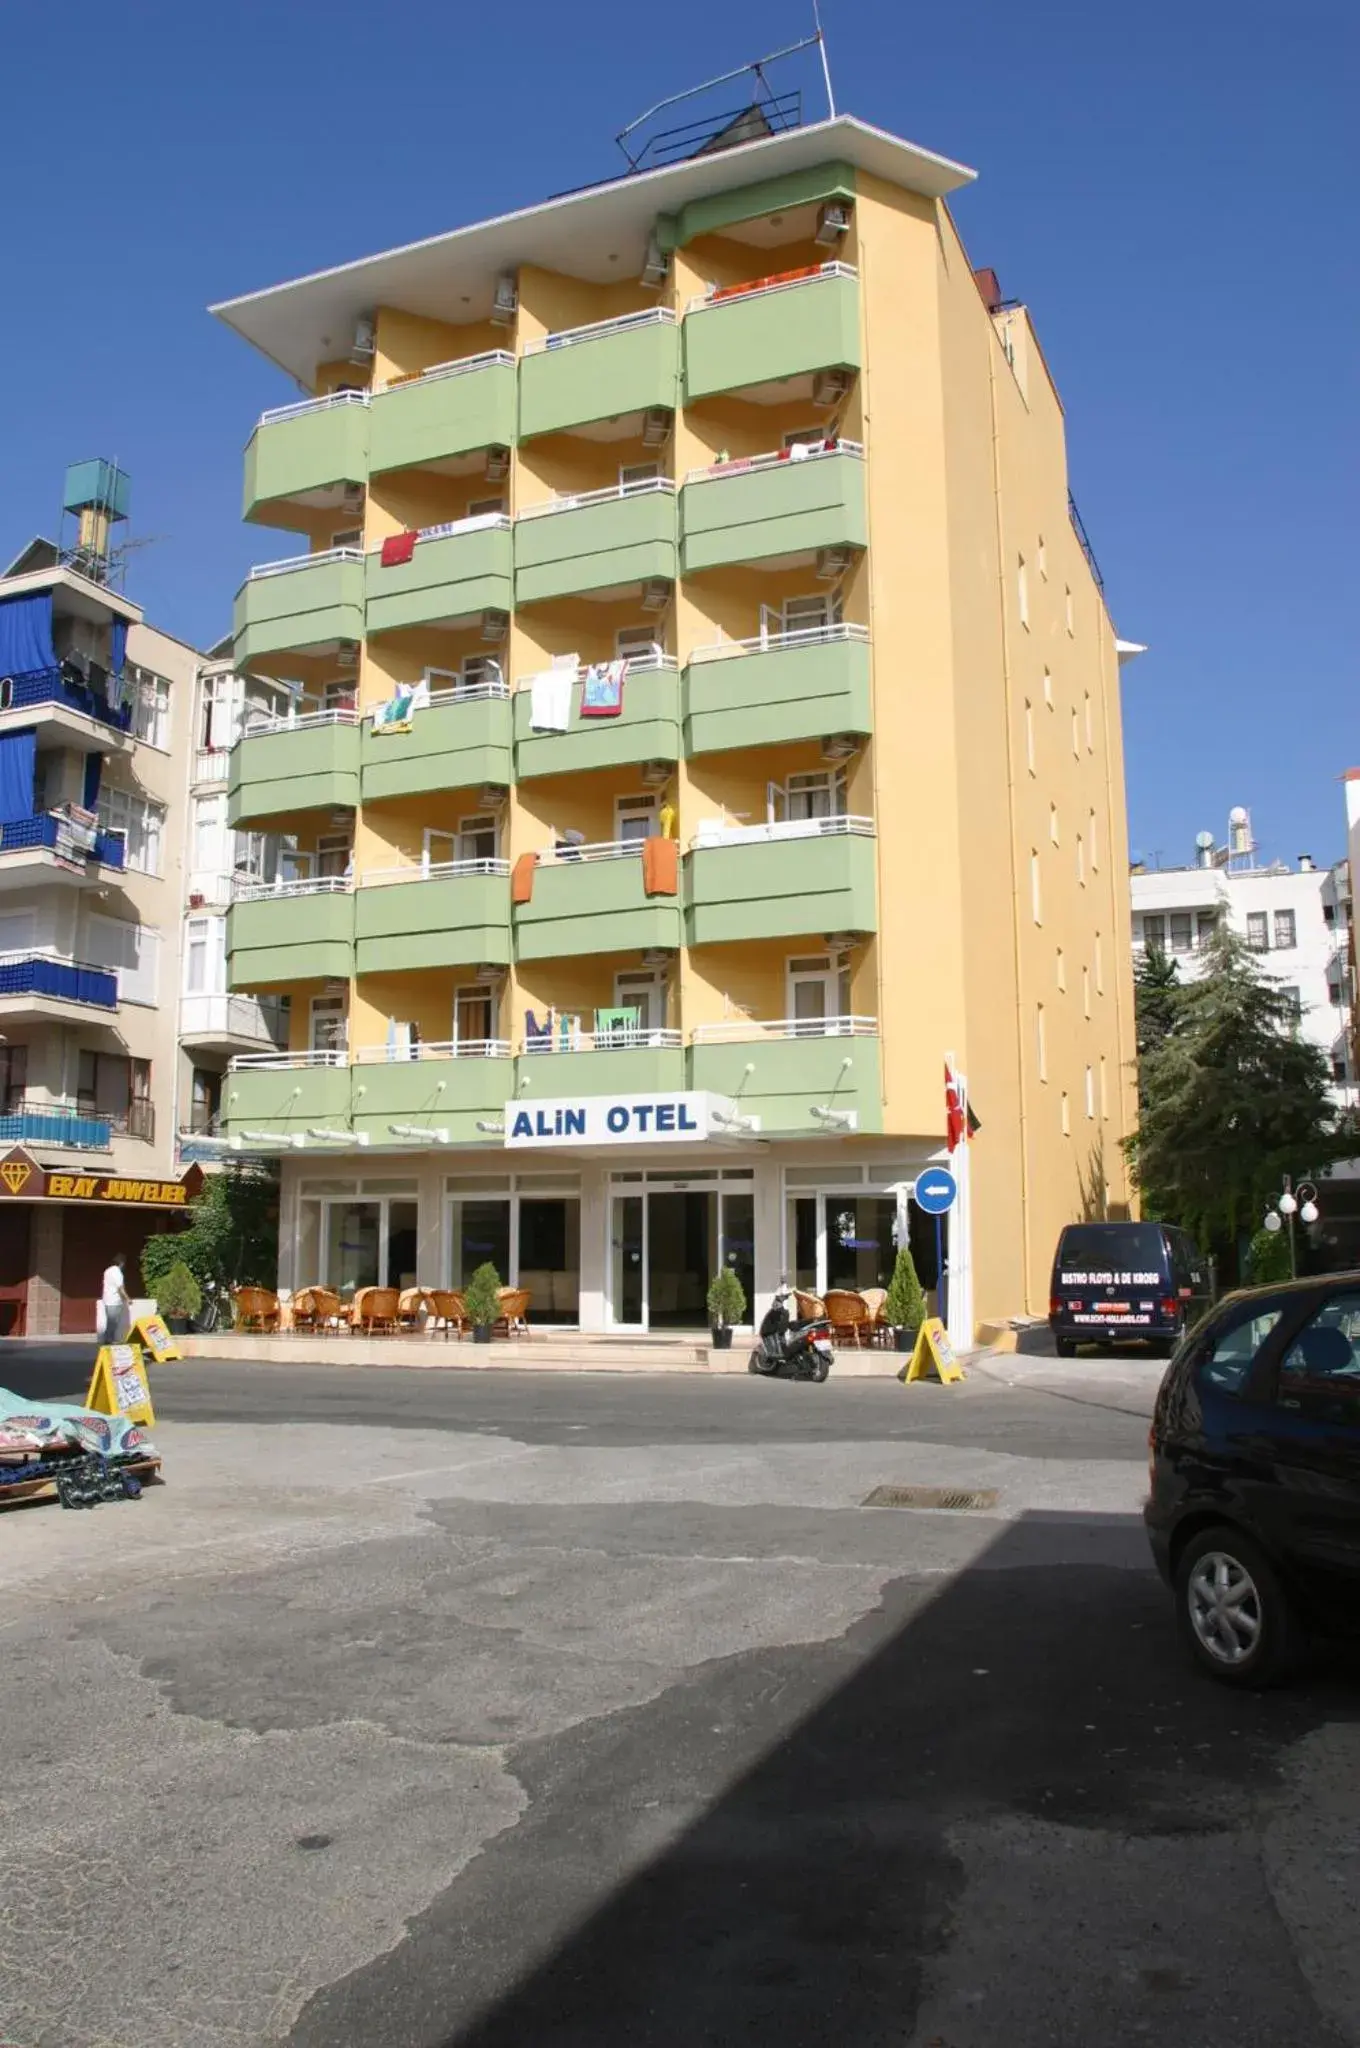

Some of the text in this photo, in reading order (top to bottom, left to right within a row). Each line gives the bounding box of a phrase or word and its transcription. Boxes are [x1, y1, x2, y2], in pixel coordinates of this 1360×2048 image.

[607, 1103, 697, 1133] OTEL
[49, 1176, 186, 1204] ERAY JUWELIER
[1062, 1272, 1087, 1284] BISTRO
[1089, 1272, 1113, 1284] FLOYD
[1114, 1272, 1120, 1284] &
[1121, 1272, 1131, 1284] DE
